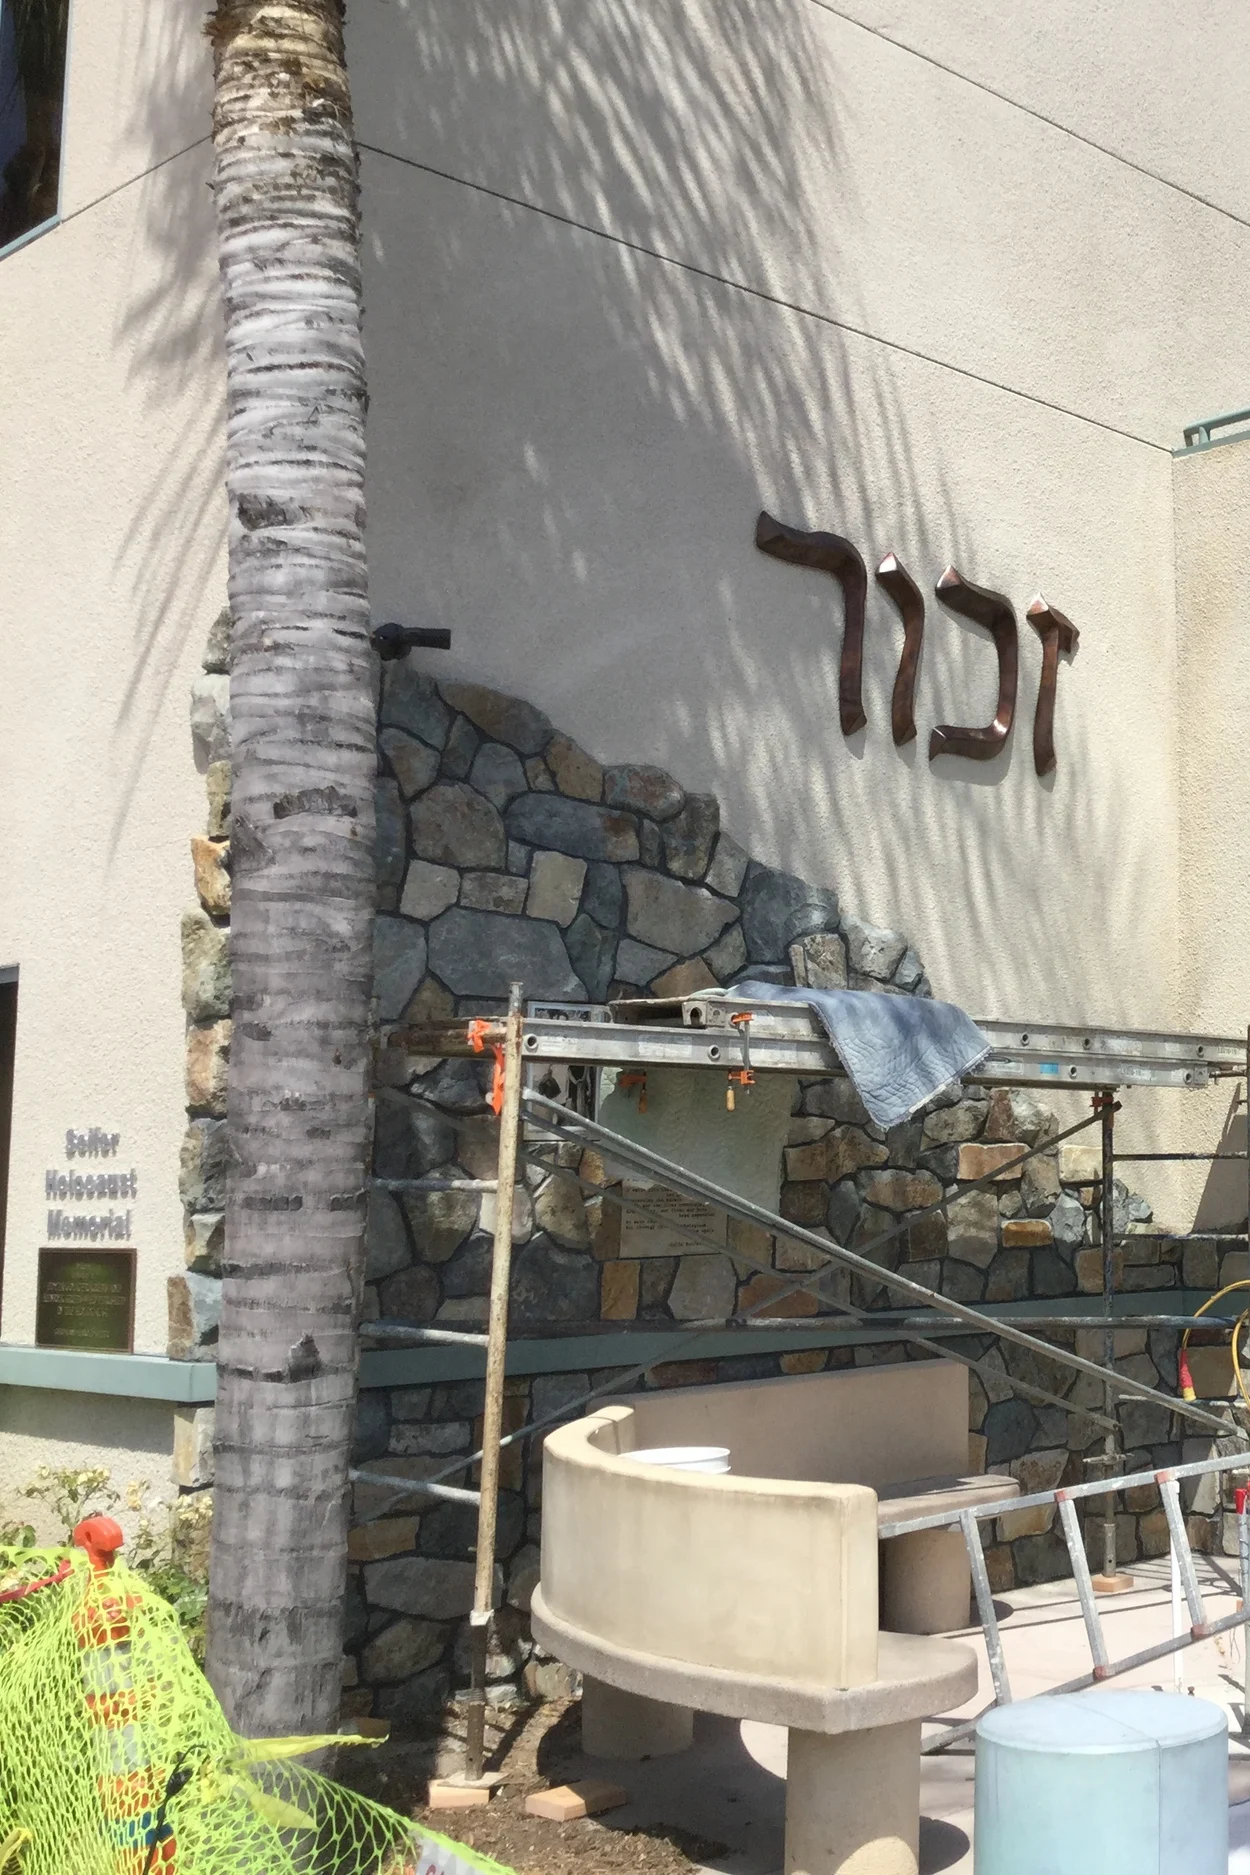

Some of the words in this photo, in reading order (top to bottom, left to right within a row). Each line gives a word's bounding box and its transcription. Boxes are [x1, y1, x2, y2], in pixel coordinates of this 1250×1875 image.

[756, 510, 1080, 777] זכור
[45, 1168, 137, 1197] Holocaust
[47, 1208, 131, 1239] Memorial
